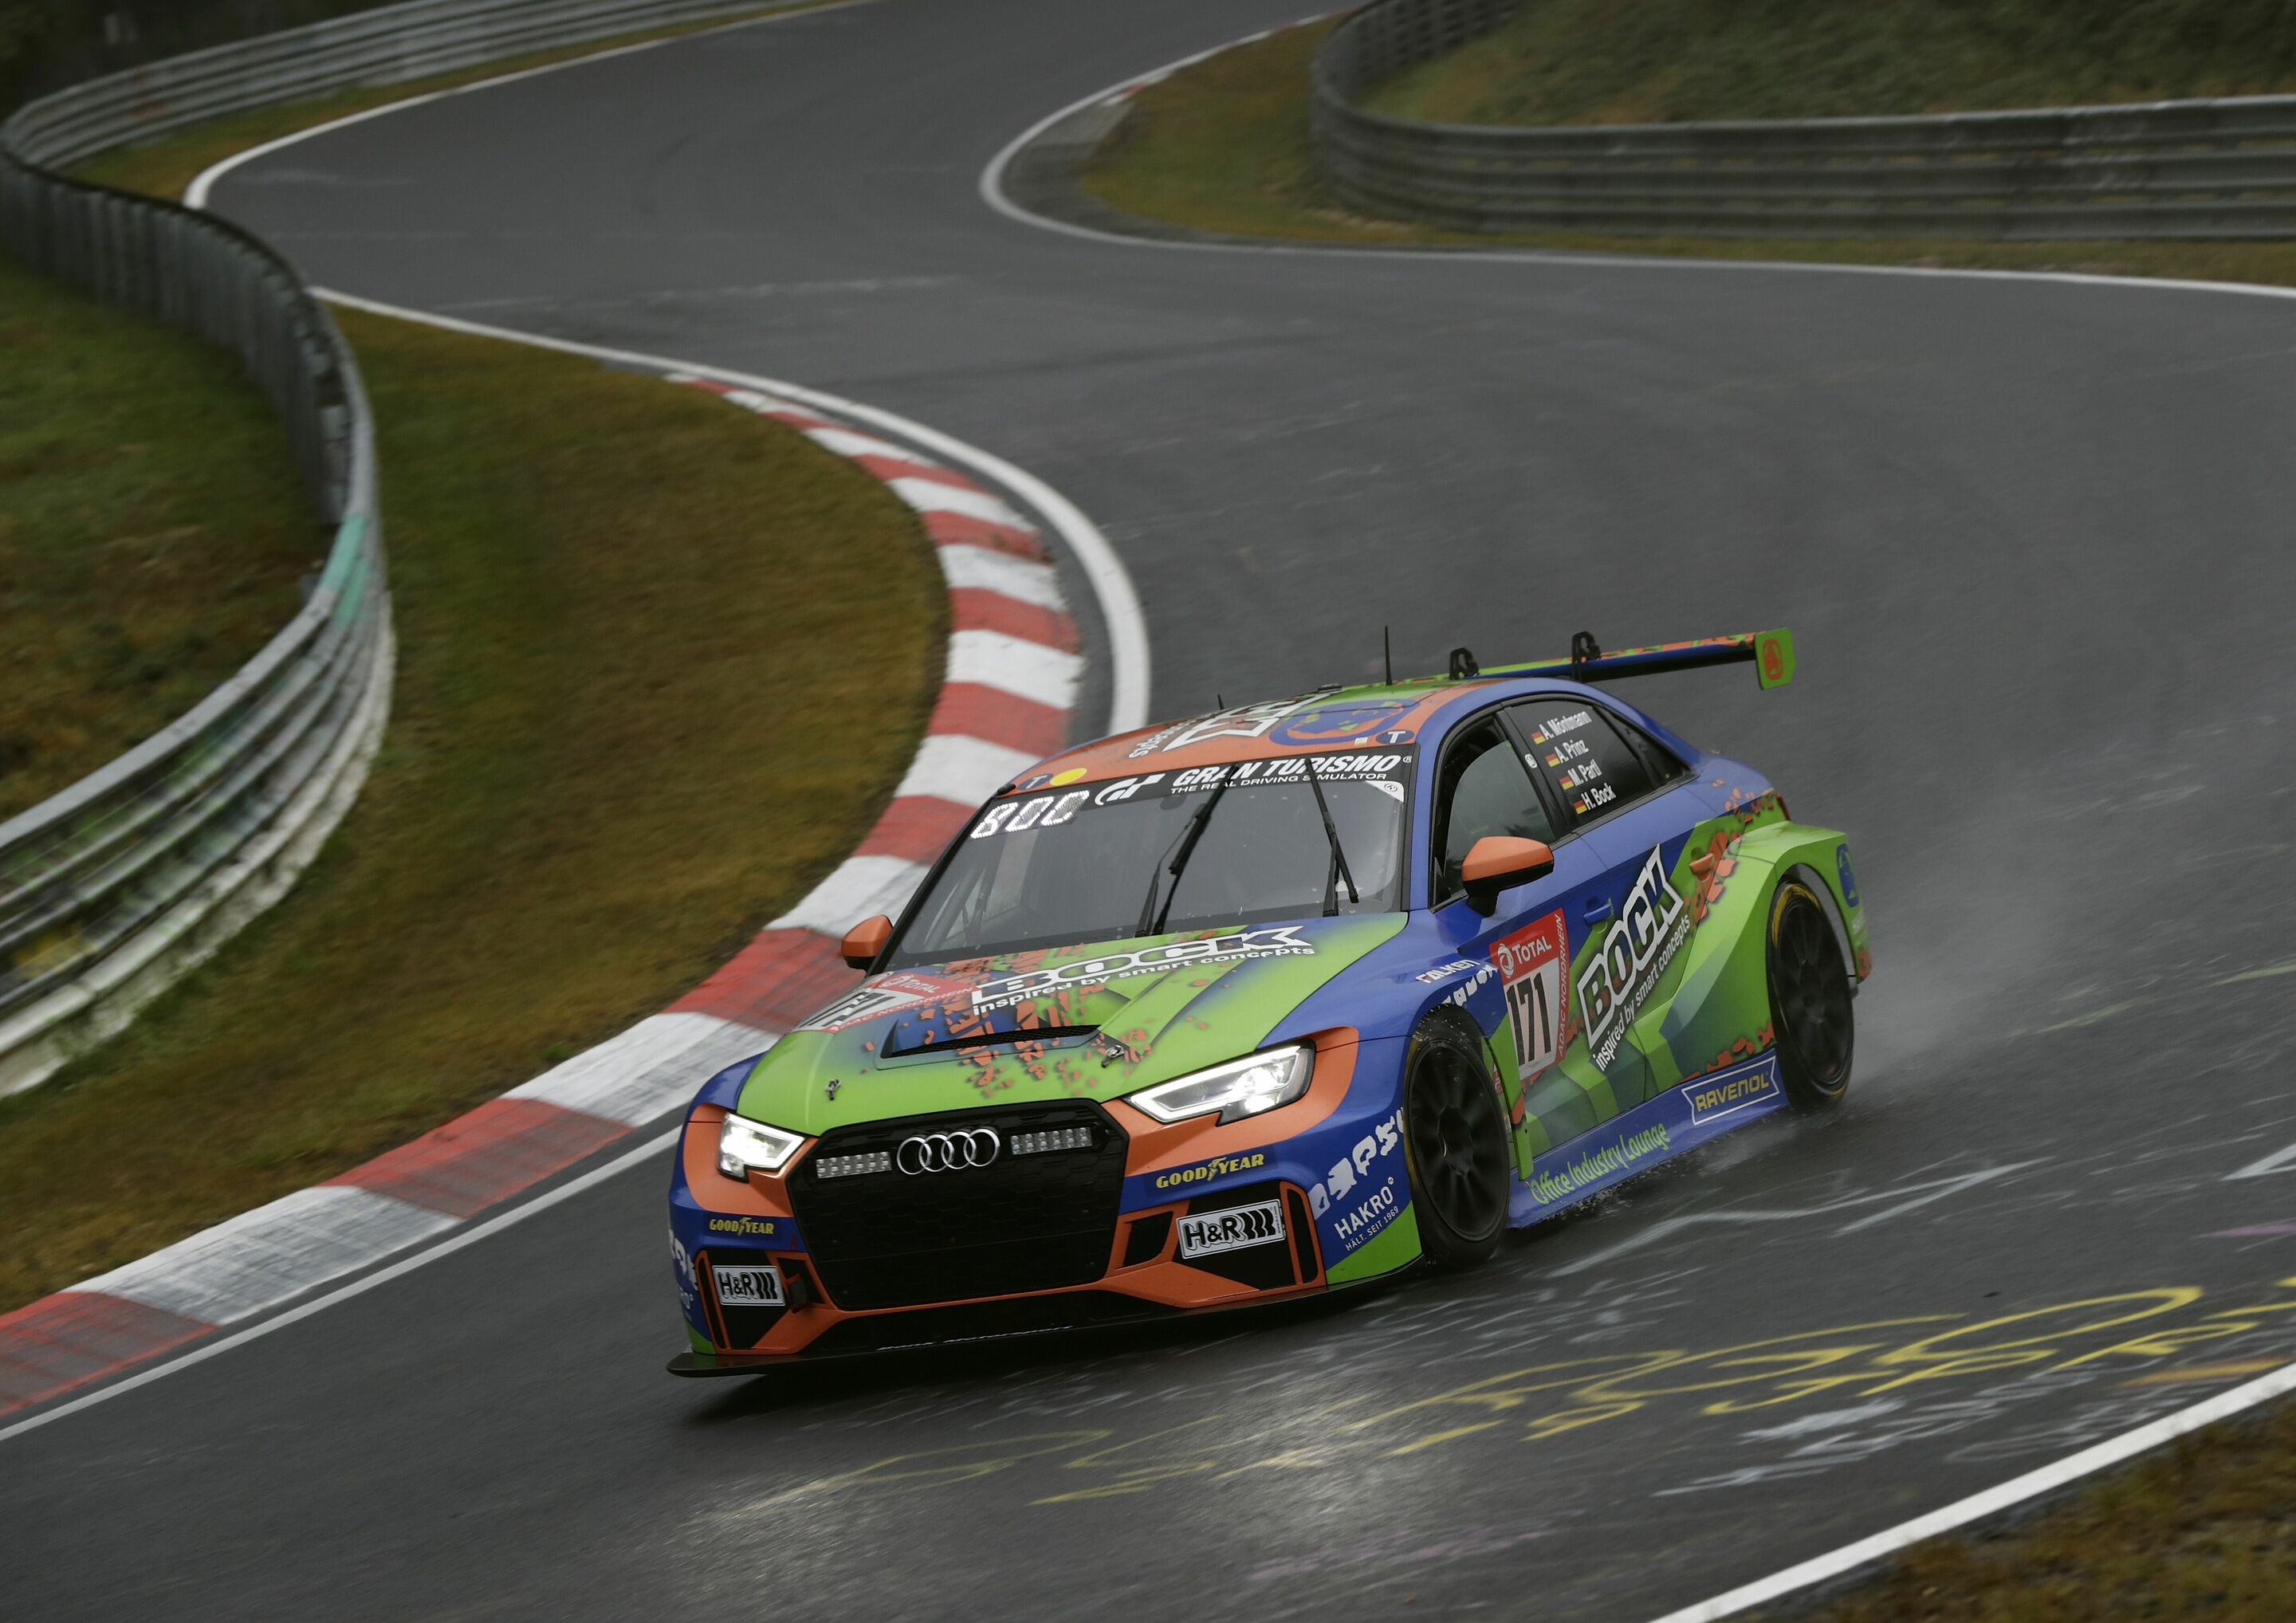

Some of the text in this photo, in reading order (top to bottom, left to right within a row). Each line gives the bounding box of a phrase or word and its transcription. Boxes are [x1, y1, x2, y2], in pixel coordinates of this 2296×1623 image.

[1554, 740, 1590, 764] A. Prinz
[1170, 785, 1197, 794] THE
[1240, 776, 1299, 786] DRIVING
[1303, 772, 1388, 781] SMULATOR
[1581, 782, 1617, 810] H. Bock
[1512, 935, 1553, 965] TOTAL
[1577, 843, 1685, 1050] BOCK
[899, 979, 942, 993] TOTAL
[973, 946, 1316, 1016] inspired by smart concepts
[1415, 959, 1480, 984] FALKEN
[1555, 914, 1568, 1058] ADAC NORDRHEIN
[1593, 914, 1691, 1072] inspired by smart concepts
[1506, 972, 1551, 1067] 171
[1695, 1073, 1769, 1112] RAVENOL
[1530, 1123, 1671, 1204] Office Industry Lounge
[1334, 1185, 1394, 1240] HAKRO
[1366, 1220, 1383, 1236] SEIT
[1383, 1205, 1400, 1223] 1969
